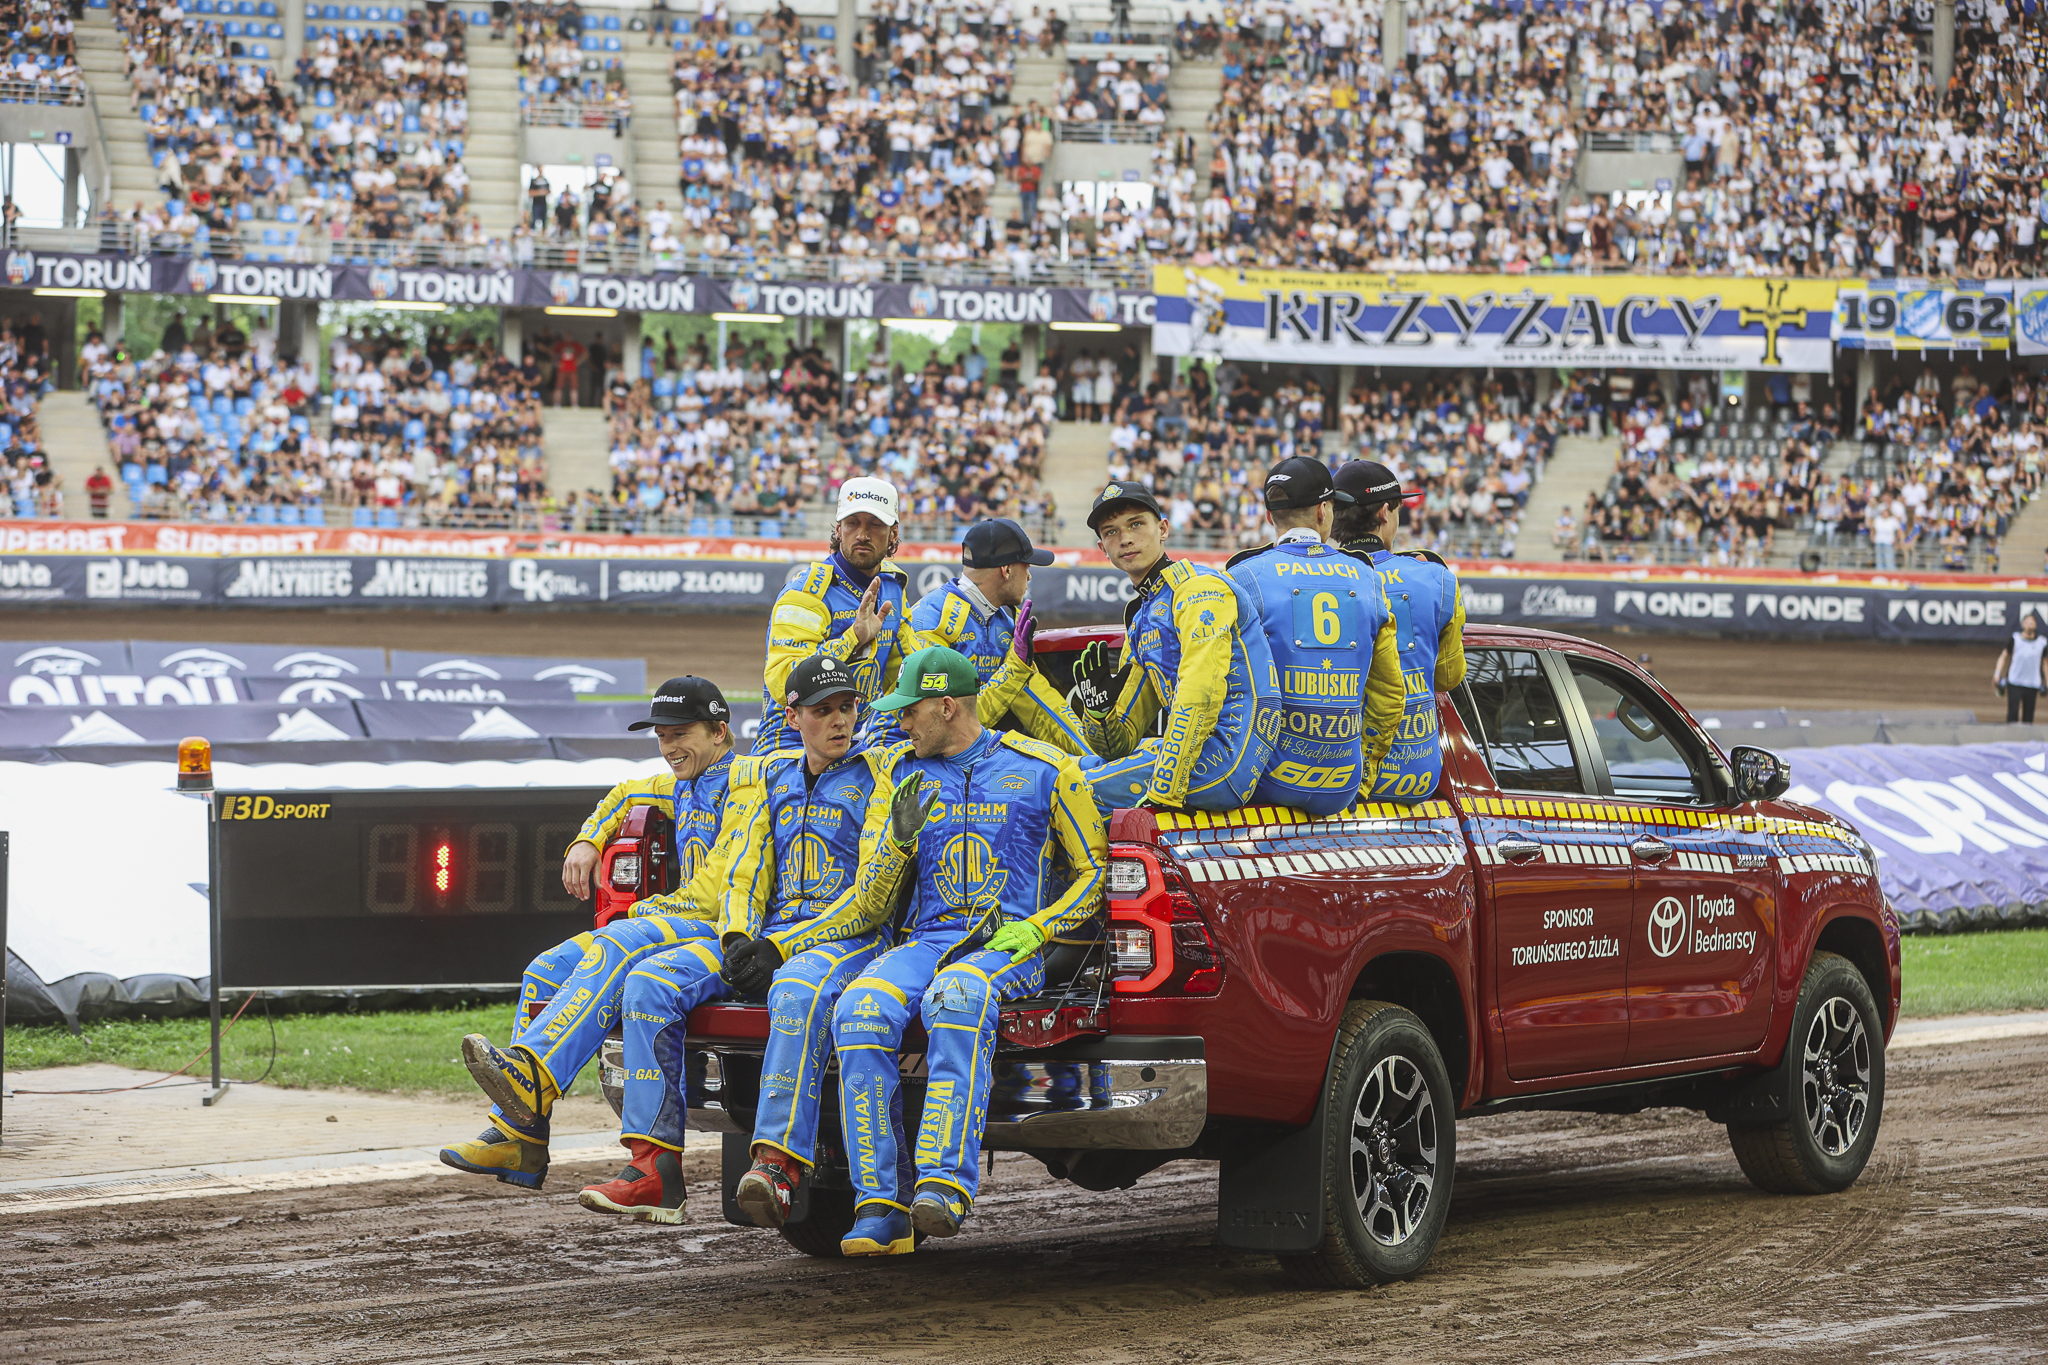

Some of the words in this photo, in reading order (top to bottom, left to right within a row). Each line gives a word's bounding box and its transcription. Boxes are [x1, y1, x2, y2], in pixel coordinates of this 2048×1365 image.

[36, 254, 152, 291] TORUŃ
[219, 264, 332, 299] TORUŃ
[400, 269, 514, 304] TORUŃ
[581, 273, 695, 312] TORUŃ
[761, 281, 874, 318] TORUŃ
[938, 287, 1053, 323] TORUŃ
[1842, 295, 1897, 331] 19
[1945, 295, 2007, 333] 62
[1262, 288, 1722, 352] KRZYŻACY
[854, 491, 889, 505] bokaro
[123, 562, 189, 588] Juta
[228, 559, 352, 598] MŁYNIEC
[364, 559, 488, 599] MŁYNIEC
[617, 570, 681, 593] SKUP
[684, 571, 764, 594] ZŁOMU
[1275, 563, 1360, 580] PALUCH
[944, 600, 963, 636] CANAL+
[1311, 591, 1342, 645] 6
[1648, 592, 1733, 617] ONDE
[1779, 596, 1864, 622] ONDE
[1921, 600, 2006, 626] ONDE
[811, 670, 849, 683] PERŁOWA
[921, 673, 948, 692] 54
[1080, 678, 1092, 691] DO
[1284, 670, 1360, 697] LUBUSKIE
[1153, 704, 1193, 794] GBSBank
[1001, 781, 1025, 790] PGE
[1268, 761, 1357, 788] 606
[1374, 771, 1433, 796] 708
[797, 805, 843, 822] KGHM
[951, 803, 1008, 816] KGHM
[950, 840, 983, 885] STAL
[1543, 907, 1594, 929] SPONSOR
[1696, 894, 1736, 924] Toyota
[1512, 940, 1587, 966] TORUŃSKIEGO
[1588, 934, 1620, 959] ŻUŻLA
[1695, 927, 1757, 954] Bednarscy
[541, 986, 594, 1041] DEWALT
[840, 1023, 852, 1033] ICT
[856, 1022, 890, 1034] Poland
[875, 1076, 884, 1099] OILS
[877, 1100, 889, 1136] MOTOR
[915, 1080, 956, 1168] WISŁOK
[855, 1090, 880, 1188] DYNAMAX
[1230, 1208, 1312, 1229] HILUX
